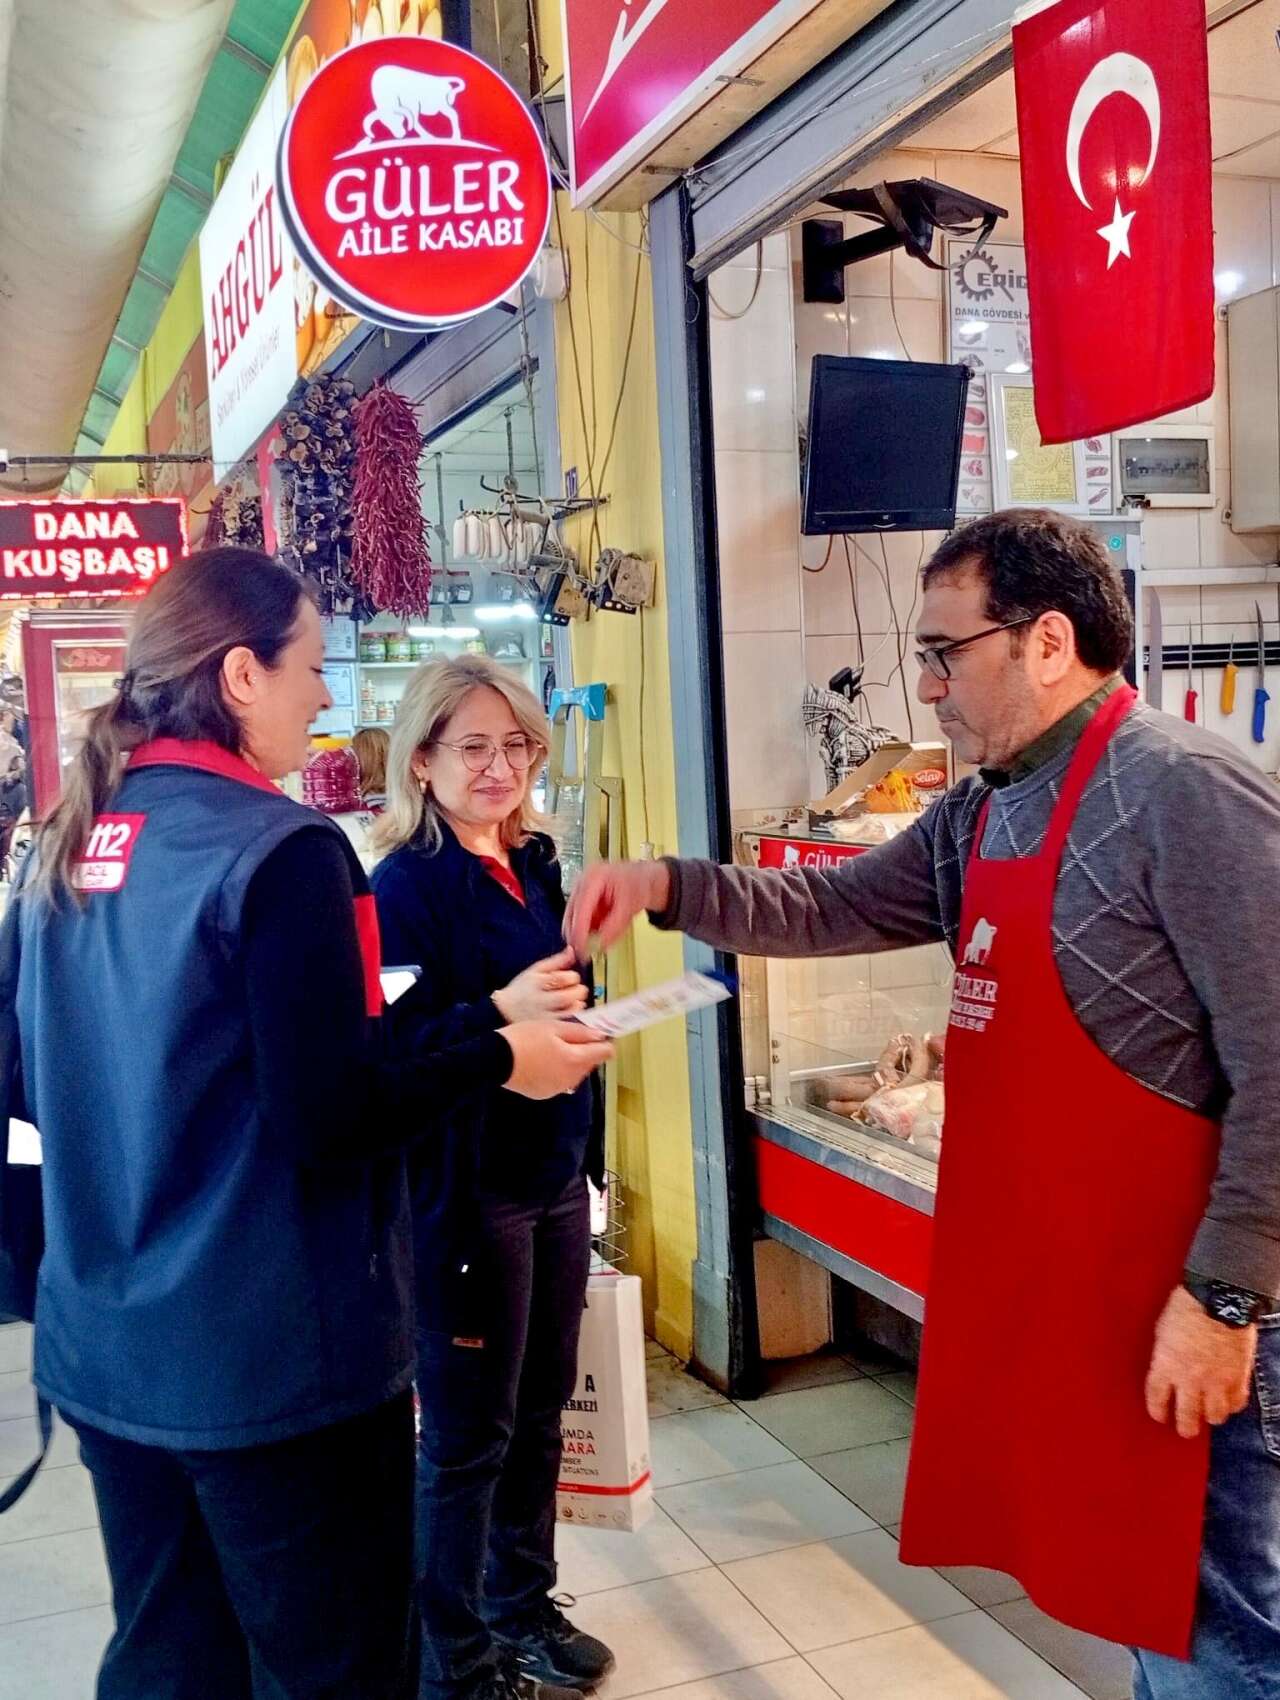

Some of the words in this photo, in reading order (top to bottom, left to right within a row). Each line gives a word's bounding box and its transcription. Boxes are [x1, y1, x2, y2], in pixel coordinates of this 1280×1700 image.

[325, 157, 525, 223] GÜLER
[337, 221, 409, 258] AİLE
[419, 217, 525, 251] KASABI
[955, 307, 980, 317] DANA
[34, 511, 139, 540] DANA
[3, 546, 168, 581] KUŞBAŞI
[85, 822, 131, 858] 112
